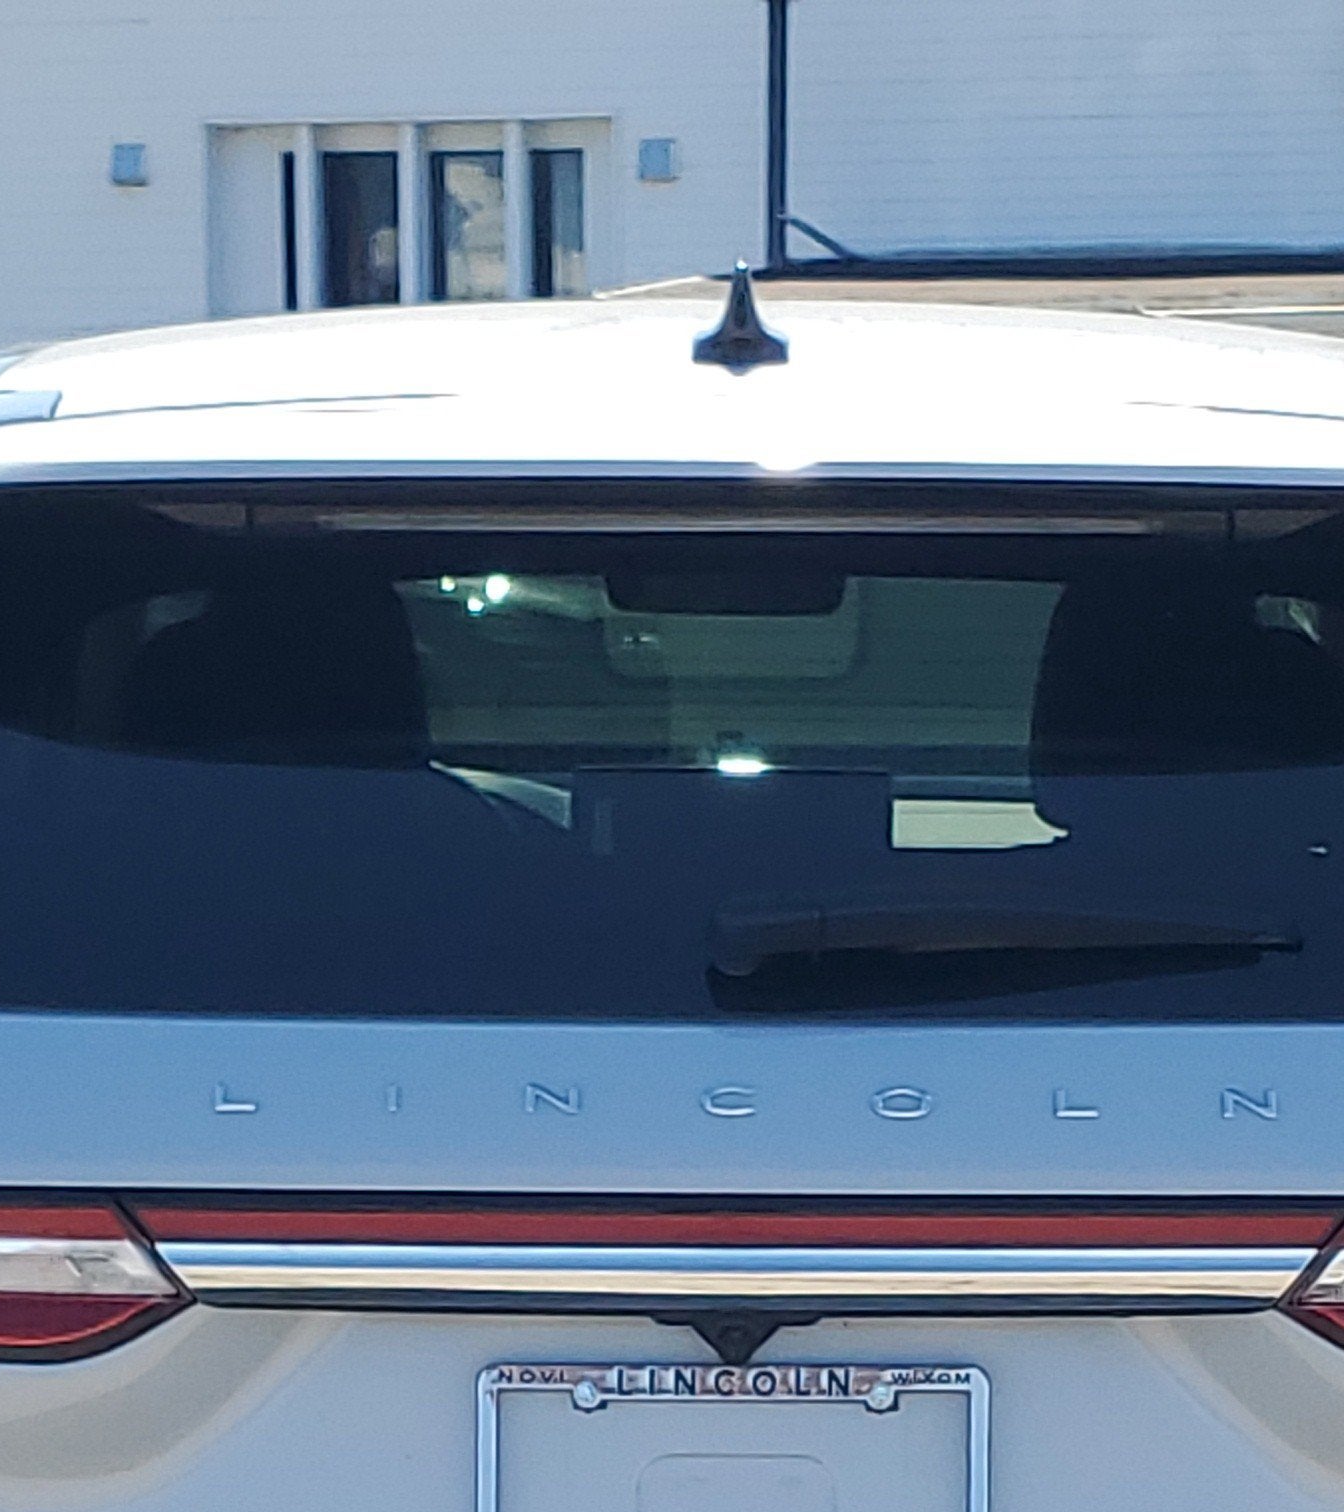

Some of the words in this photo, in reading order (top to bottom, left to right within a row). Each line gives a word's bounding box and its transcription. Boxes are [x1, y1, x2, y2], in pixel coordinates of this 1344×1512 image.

[213, 1083, 1278, 1118] LINCOLN
[498, 1369, 567, 1384] NOVI
[617, 1368, 850, 1397] LINCOLN
